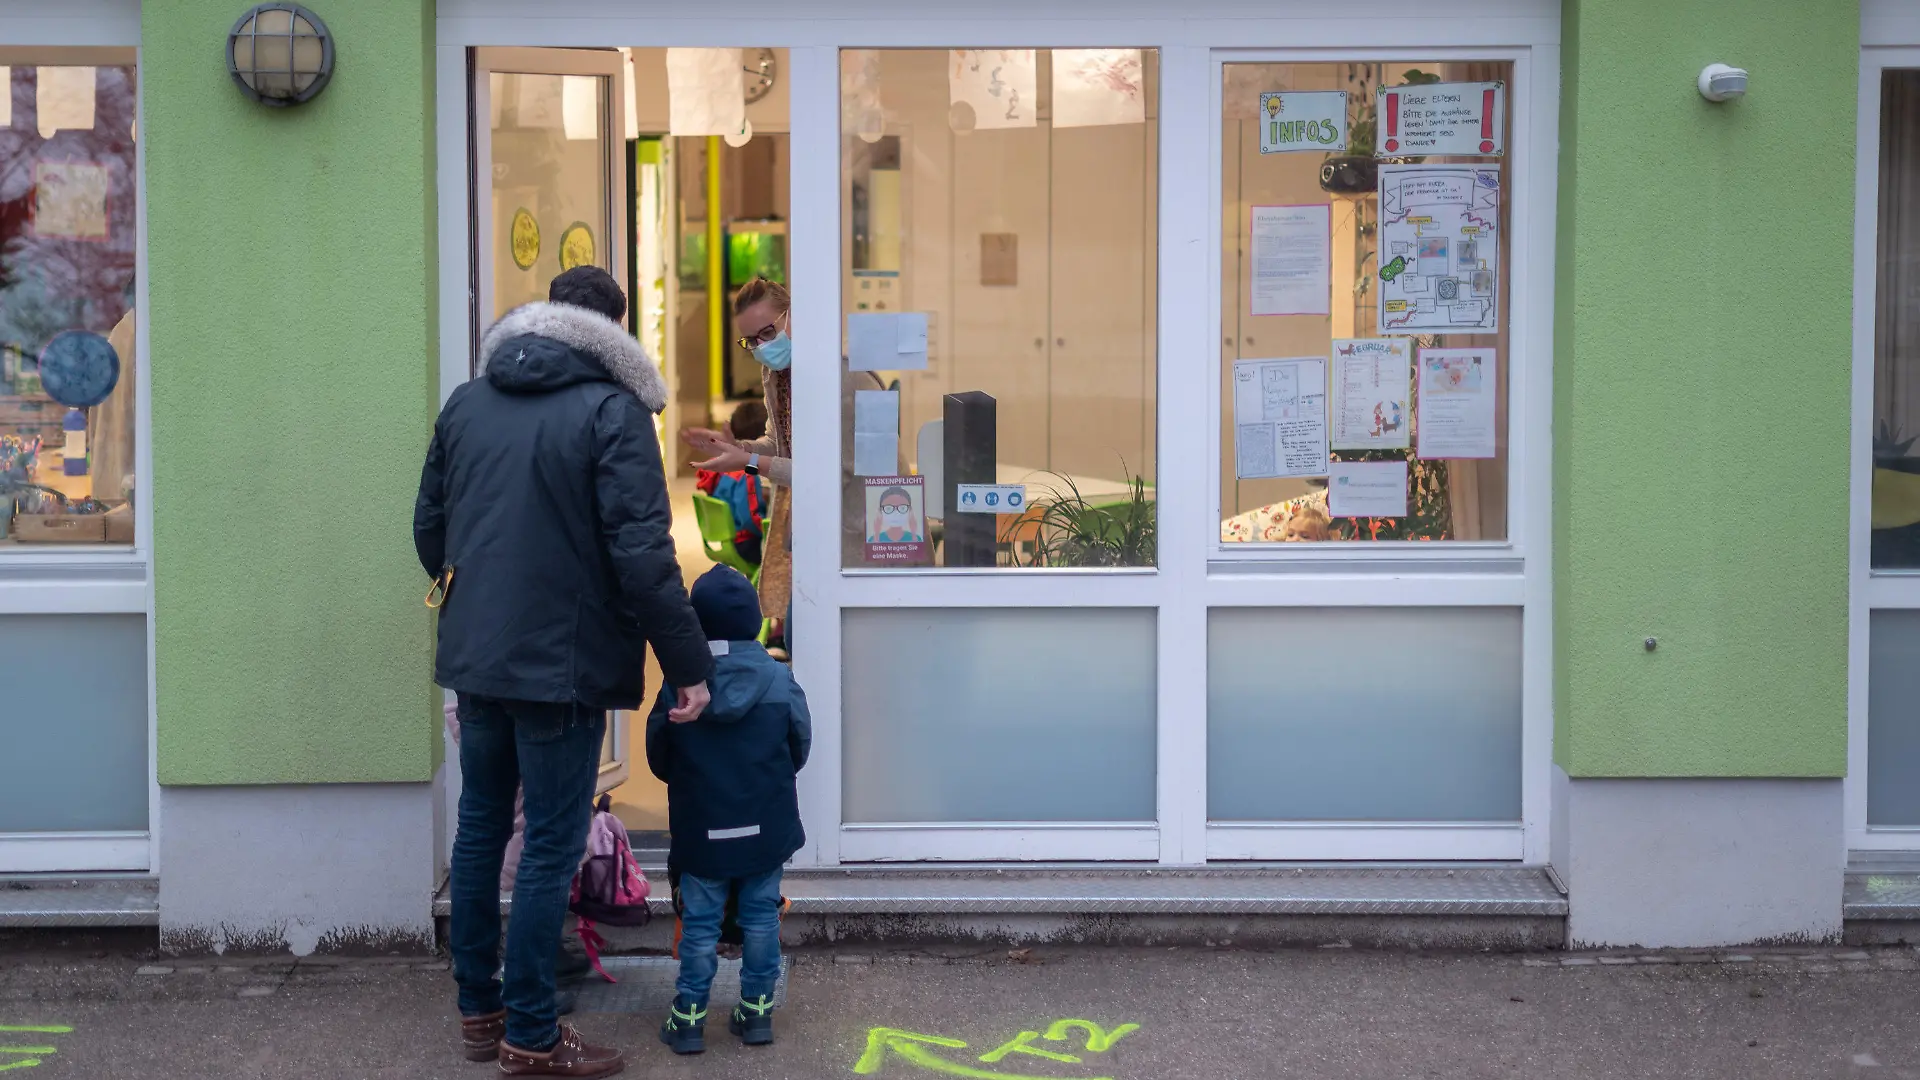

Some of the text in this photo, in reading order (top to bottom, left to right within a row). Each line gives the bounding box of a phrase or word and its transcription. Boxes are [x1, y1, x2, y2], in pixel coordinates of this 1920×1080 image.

[1402, 109, 1421, 119] BITTE
[1270, 118, 1338, 145] INFOS
[865, 477, 923, 485] MASKENPFLICHT
